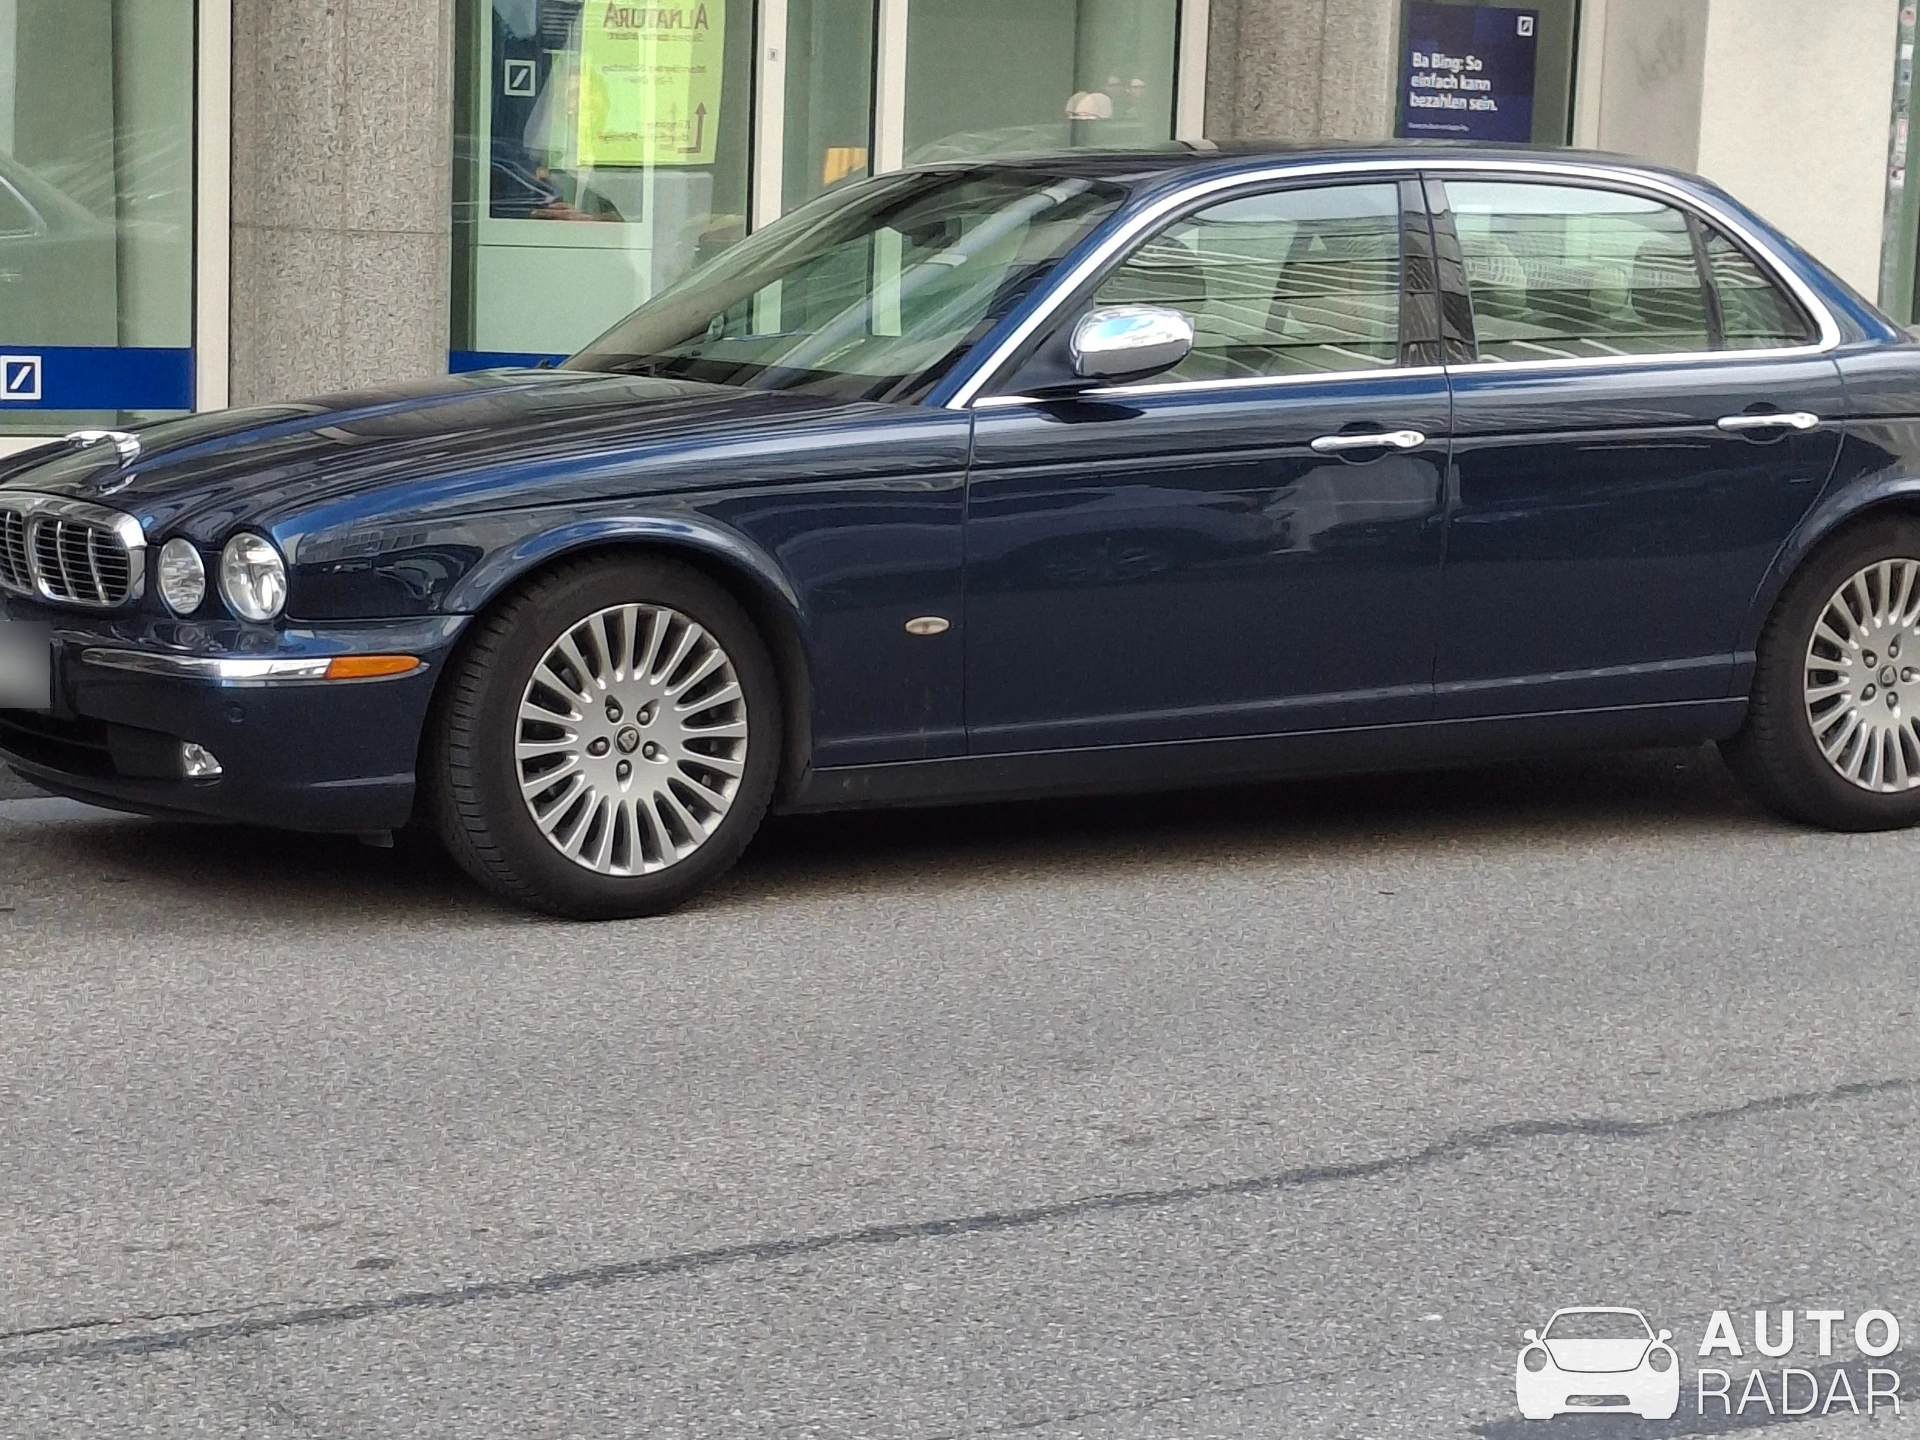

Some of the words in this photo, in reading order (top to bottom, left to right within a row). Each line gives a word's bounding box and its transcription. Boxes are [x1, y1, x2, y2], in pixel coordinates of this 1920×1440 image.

[1412, 52, 1429, 68] Ba
[1465, 55, 1482, 71] So
[1411, 72, 1458, 89] einfach
[1460, 74, 1491, 91] kann
[1410, 91, 1467, 109] bezahlen
[1469, 95, 1498, 111] sein.
